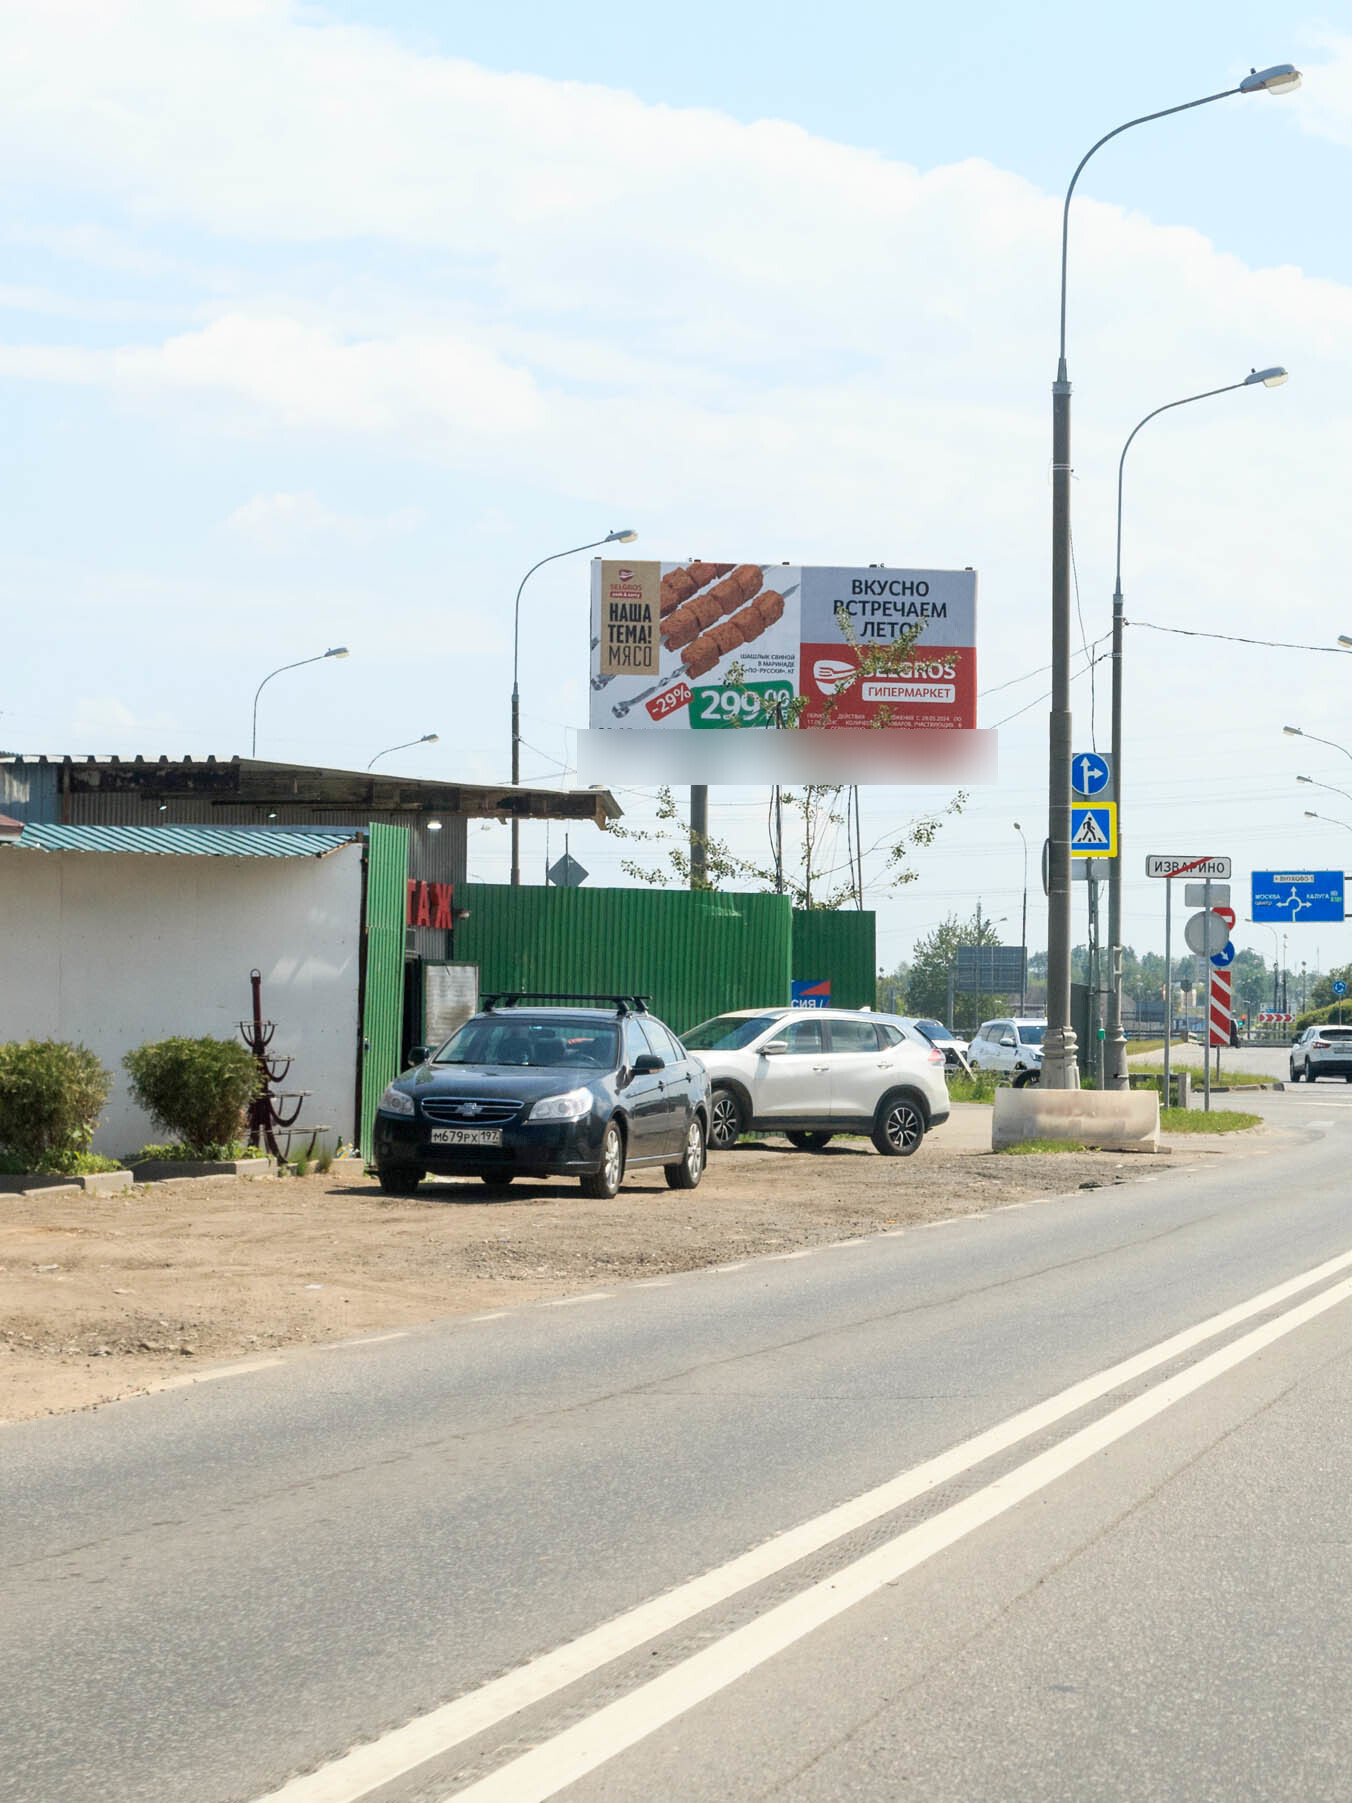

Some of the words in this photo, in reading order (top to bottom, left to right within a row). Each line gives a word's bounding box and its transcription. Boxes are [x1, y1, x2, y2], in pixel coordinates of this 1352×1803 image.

[851, 579, 930, 597] ВКУСНО
[608, 603, 652, 623] НАША
[833, 600, 947, 618] ВСТРЕЧАЕМ
[607, 624, 652, 644] ТЕМА!
[608, 646, 652, 667] МЯСО
[652, 684, 692, 713] -29%
[868, 686, 951, 699] ГИПЕРМАРКЕТ
[701, 690, 760, 720] 299
[433, 1131, 478, 1142] М679РХ
[480, 1131, 497, 1140] 197
